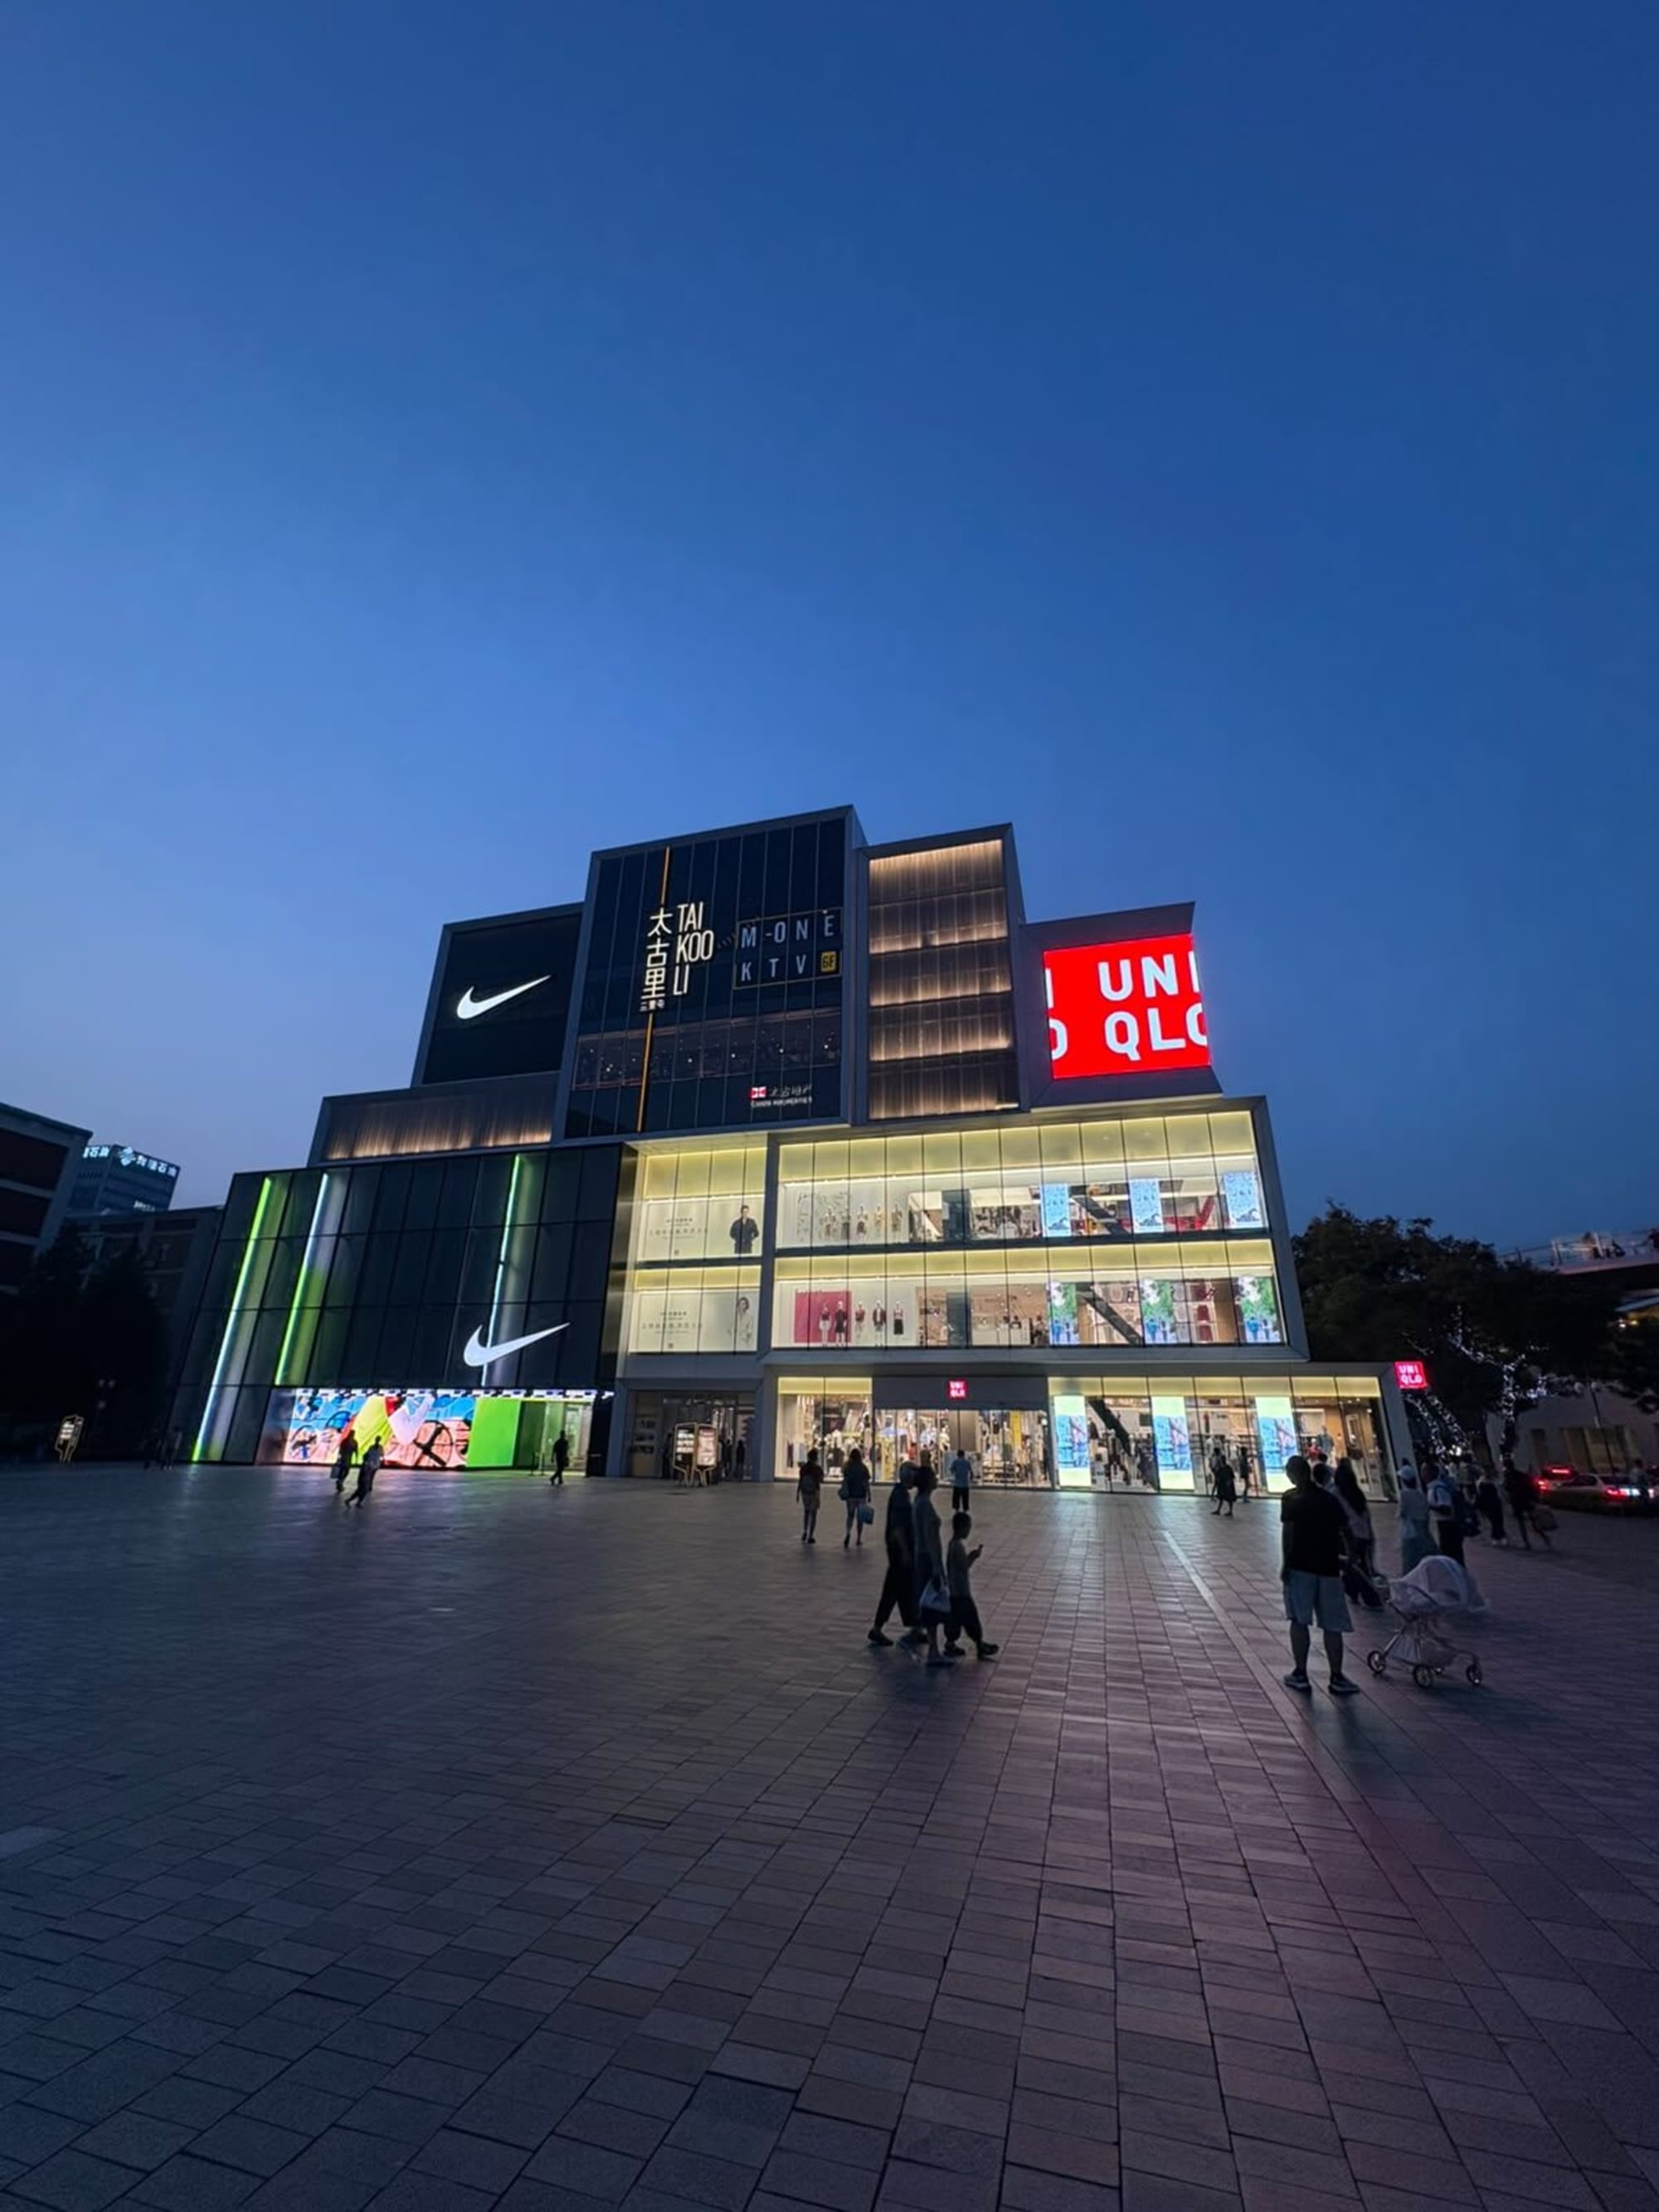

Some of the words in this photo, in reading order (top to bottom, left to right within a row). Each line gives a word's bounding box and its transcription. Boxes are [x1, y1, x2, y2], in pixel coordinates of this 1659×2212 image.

[677, 901, 703, 932] TAI
[640, 907, 673, 999] 太古里
[676, 930, 714, 964] KOO
[673, 964, 689, 995] LI
[741, 954, 807, 981] KTV
[1401, 1374, 1423, 1385] QLO
